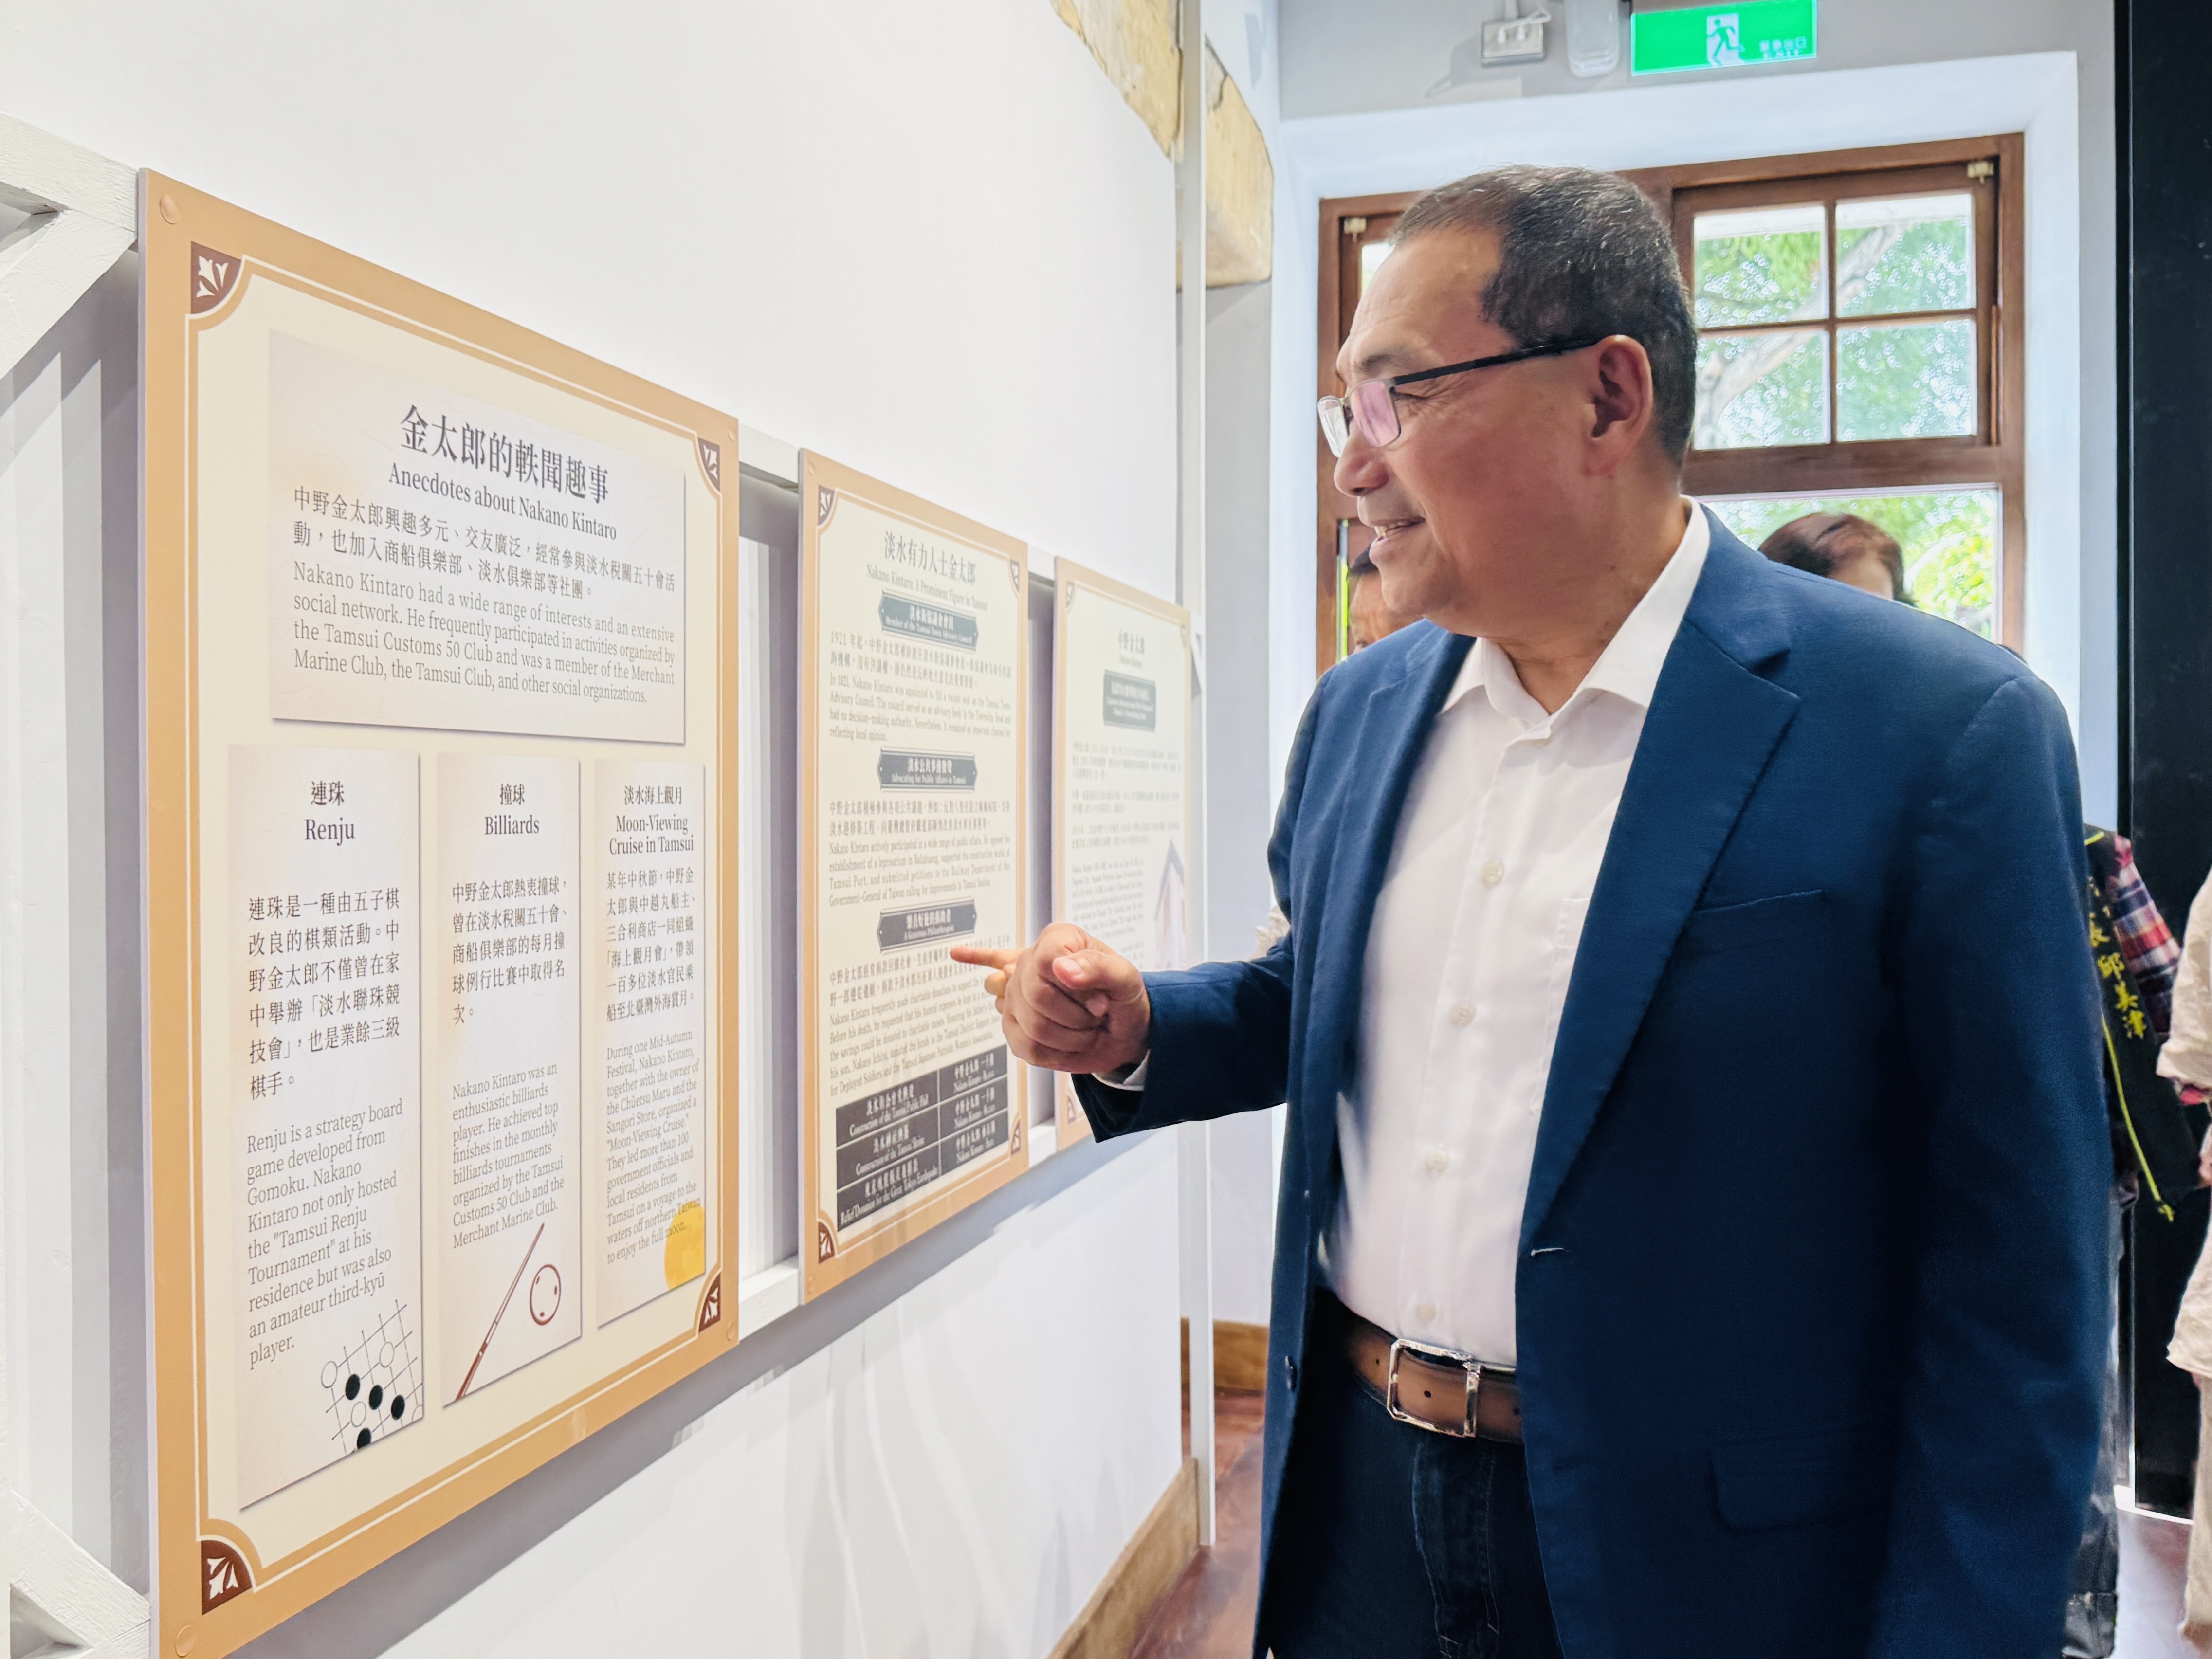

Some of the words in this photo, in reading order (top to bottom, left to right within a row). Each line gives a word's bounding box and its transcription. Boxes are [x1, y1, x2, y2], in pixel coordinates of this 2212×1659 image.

[400, 405, 609, 504] 金太郎的軼聞趣事
[389, 462, 470, 503] Anecdotes
[475, 486, 515, 515] about
[519, 497, 568, 529] Nakano
[572, 511, 617, 540] Kintaro
[885, 530, 976, 586] 淡水有力人士金太郎
[294, 561, 354, 589] Nakano
[360, 573, 414, 599] Kintaro
[419, 582, 443, 604] had
[448, 593, 455, 606] a
[459, 592, 489, 612] wide
[494, 602, 526, 622] range
[530, 603, 542, 620] of
[546, 605, 591, 629] interests
[595, 617, 613, 633] and
[617, 623, 628, 635] an
[632, 625, 674, 642] extensive
[867, 565, 890, 583] Nakano
[921, 582, 948, 601] Prominent
[294, 593, 337, 615] social
[341, 602, 402, 624] network.
[407, 608, 425, 627] He
[429, 610, 491, 642] frequently
[494, 624, 559, 649] participated
[562, 632, 572, 649] in
[575, 636, 617, 655] activities
[620, 645, 662, 662] organized
[665, 648, 675, 664] by
[294, 619, 319, 640] the
[324, 623, 379, 648] Tamsui
[384, 632, 442, 656] Customs
[446, 640, 460, 658] 50
[464, 642, 493, 662] Club
[496, 648, 517, 665] and
[521, 654, 542, 668] was
[546, 657, 551, 670] a
[555, 657, 598, 675] member
[601, 660, 611, 677] of
[614, 662, 629, 679] the
[632, 665, 674, 685] Merchant
[294, 648, 347, 672] Marine
[351, 655, 387, 681] Club,
[392, 658, 412, 679] the
[416, 662, 461, 684] Tamsui
[465, 668, 494, 691] Club,
[498, 673, 519, 690] and
[522, 674, 550, 693] other
[552, 679, 581, 696] social
[584, 684, 646, 702] organizations.
[311, 781, 344, 806] 連珠
[500, 783, 525, 806] 撞球
[624, 785, 682, 805] 淡水海上觀月
[305, 818, 354, 846] Renju
[485, 815, 539, 835] Billiards
[616, 815, 688, 834] Moon-Viewing
[609, 837, 643, 855] Cruise
[646, 836, 656, 853] in
[658, 835, 694, 852] Tamsui
[249, 888, 400, 921] 連珠是一種由五子棋
[249, 919, 400, 956] 改良的棋類活動。中
[453, 931, 565, 964] 商船俱樂部的每月撞
[249, 952, 400, 993] 野金太郎不僅曾在家
[453, 959, 565, 994] 球例行比賽中取得名
[250, 984, 400, 1028] 中舉辦「淡水聯珠競
[453, 1004, 474, 1025] 次。
[607, 1044, 633, 1060] During
[634, 1042, 648, 1053] one
[650, 1031, 692, 1050] Mid-Autumn
[607, 1058, 637, 1079] Festival,
[639, 1055, 666, 1070] Nakano
[668, 1048, 694, 1062] Kintaro,
[251, 1071, 294, 1100] 棋手。
[453, 1081, 490, 1100] Nakano
[492, 1072, 526, 1090] Kintaro
[528, 1067, 545, 1079] was
[547, 1064, 557, 1076] an
[453, 1096, 510, 1121] enthusiastic
[512, 1082, 548, 1105] billiards
[607, 1101, 619, 1115] the
[621, 1094, 650, 1111] Chūetsu
[652, 1088, 670, 1102] Maru
[672, 1080, 685, 1096] and
[686, 1078, 697, 1092] the
[247, 1129, 287, 1153] Renju
[291, 1125, 301, 1142] is
[305, 1126, 312, 1138] a
[316, 1112, 366, 1136] strategy
[369, 1098, 402, 1122] board
[453, 1124, 485, 1147] player.
[488, 1117, 501, 1132] He
[503, 1102, 542, 1128] achieved
[544, 1103, 558, 1117] top
[607, 1126, 661, 1152] "Moon-Viewing
[663, 1113, 689, 1133] Cruise."
[247, 1159, 284, 1185] game
[288, 1134, 353, 1168] developed
[357, 1131, 385, 1150] from
[453, 1159, 493, 1185] billiards
[495, 1143, 551, 1171] tournaments
[607, 1156, 626, 1171] They
[627, 1148, 639, 1164] led
[640, 1145, 659, 1159] more
[660, 1138, 676, 1152] than
[678, 1131, 689, 1146] 100
[247, 1176, 309, 1205] Gomoku.
[313, 1163, 361, 1187] Nakano
[607, 1189, 625, 1208] local
[627, 1180, 659, 1201] residents
[661, 1173, 677, 1187] from
[248, 1239, 270, 1259] the
[274, 1222, 328, 1248] "Tamsui
[331, 1209, 366, 1232] Renju
[454, 1221, 499, 1249] Merchant
[502, 1209, 533, 1230] Marine
[536, 1197, 558, 1216] Club.
[248, 1239, 335, 1285] Tournament"
[339, 1237, 350, 1254] at
[354, 1231, 371, 1249] his
[250, 1321, 266, 1338] an
[270, 1297, 326, 1330] amateur
[329, 1272, 384, 1307] third-kyū
[250, 1336, 294, 1370] player.
